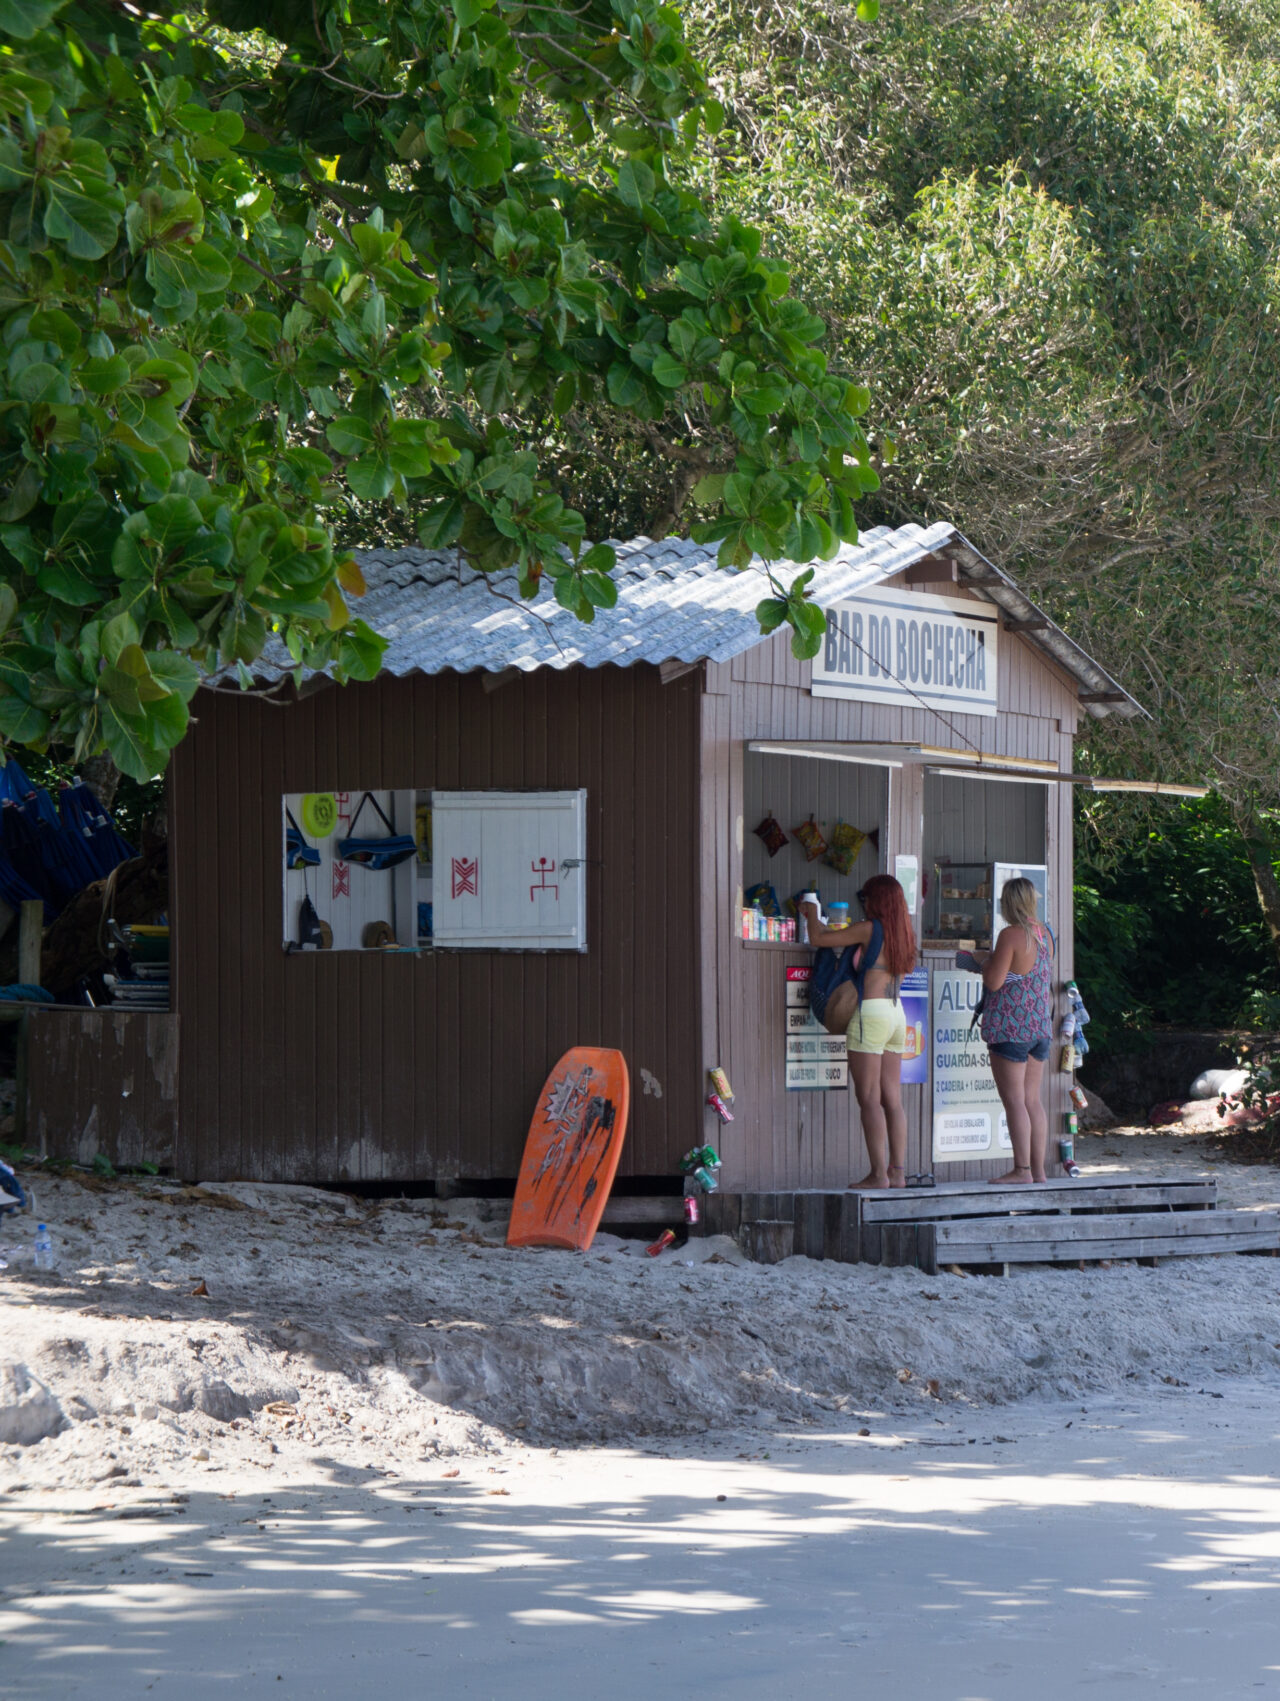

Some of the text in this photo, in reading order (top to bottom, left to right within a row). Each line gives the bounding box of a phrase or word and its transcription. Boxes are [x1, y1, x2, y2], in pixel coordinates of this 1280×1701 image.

[824, 608, 986, 691] BAR DO BOCHECHA
[937, 981, 980, 1011] ALU
[936, 1029, 980, 1043] CADEIRA
[825, 1068, 841, 1080] SUCO
[936, 1080, 940, 1093] 2
[941, 1080, 964, 1092] CADEIRA
